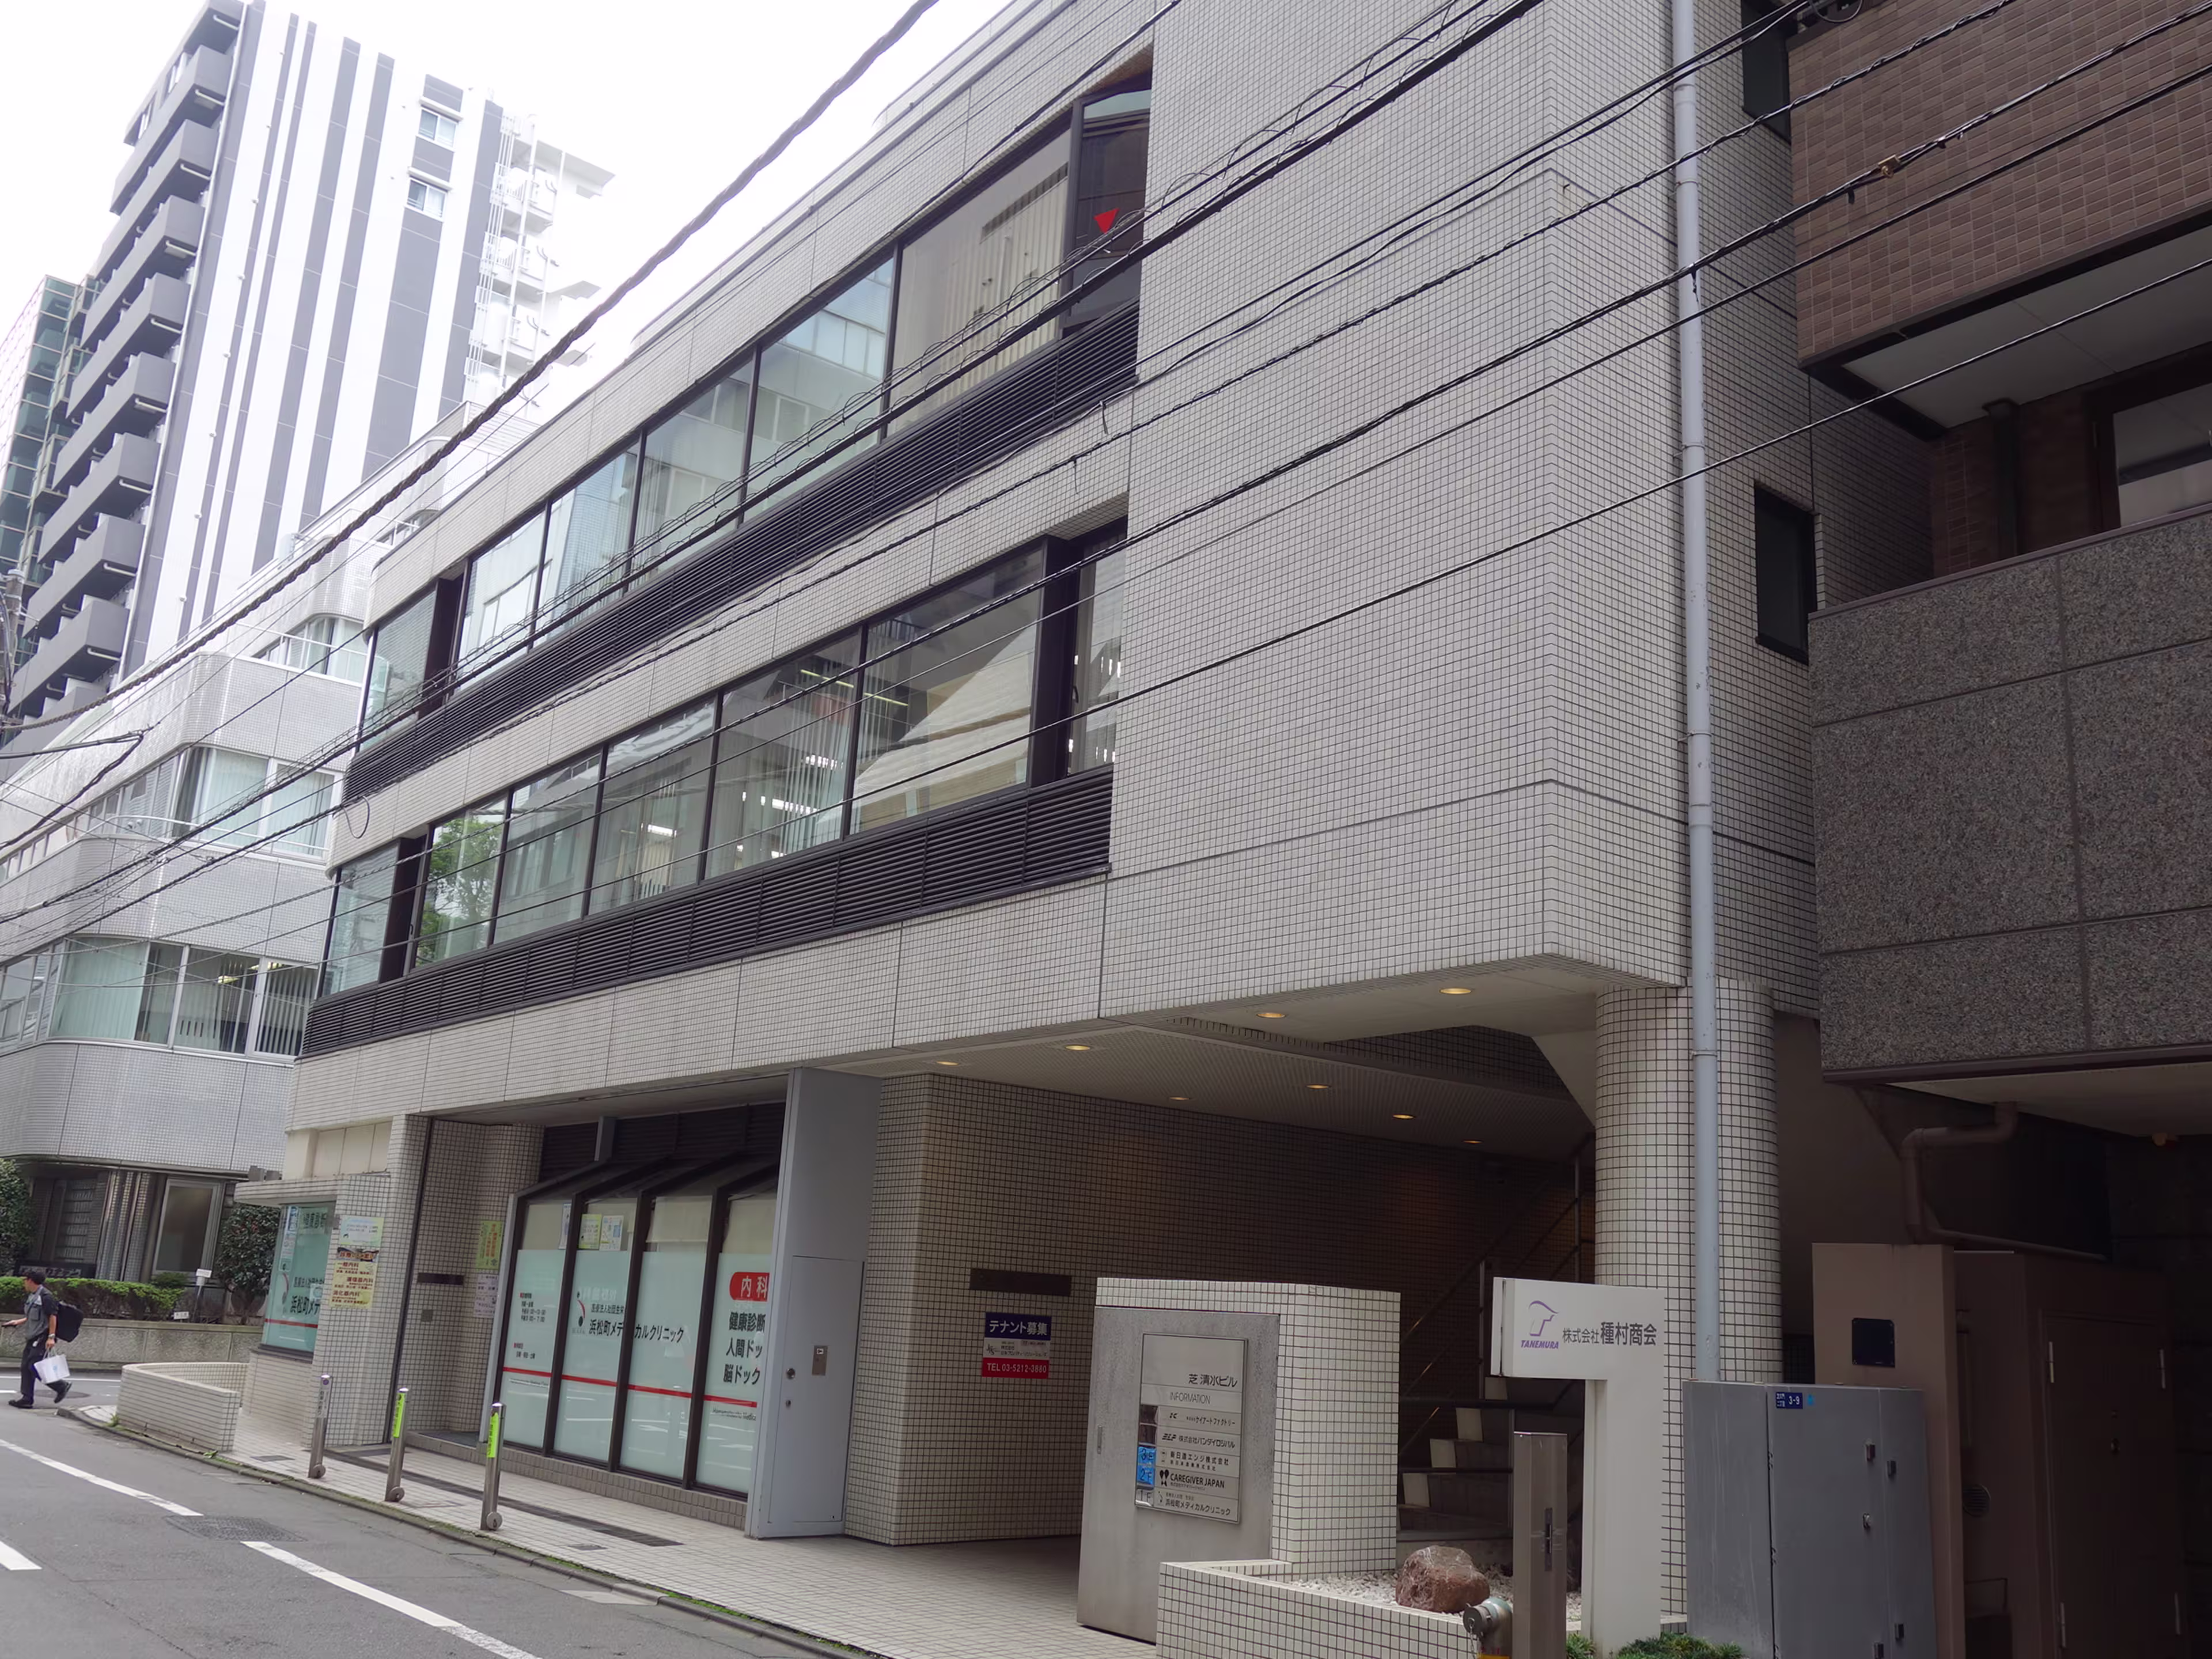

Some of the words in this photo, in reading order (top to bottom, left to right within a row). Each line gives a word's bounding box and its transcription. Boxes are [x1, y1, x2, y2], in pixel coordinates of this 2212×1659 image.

[741, 1275, 768, 1298] 内科
[729, 1312, 766, 1332] 健康診断
[989, 1320, 1048, 1335] テナント募集
[1521, 1340, 1559, 1349] TANEMURA
[723, 1363, 761, 1385] 脳ドック
[987, 1363, 1001, 1372] TEL
[1001, 1363, 1047, 1373] 03-5212-3880
[1170, 1392, 1211, 1404] INFORMATION
[1788, 1396, 1800, 1405] 3-9
[1187, 1415, 1236, 1426] ケイアートファクトリー
[1170, 1473, 1203, 1486] CAREGIVER
[1204, 1477, 1225, 1488] JAPAN
[1165, 1498, 1231, 1516] 浜松町メディカルクリニック
